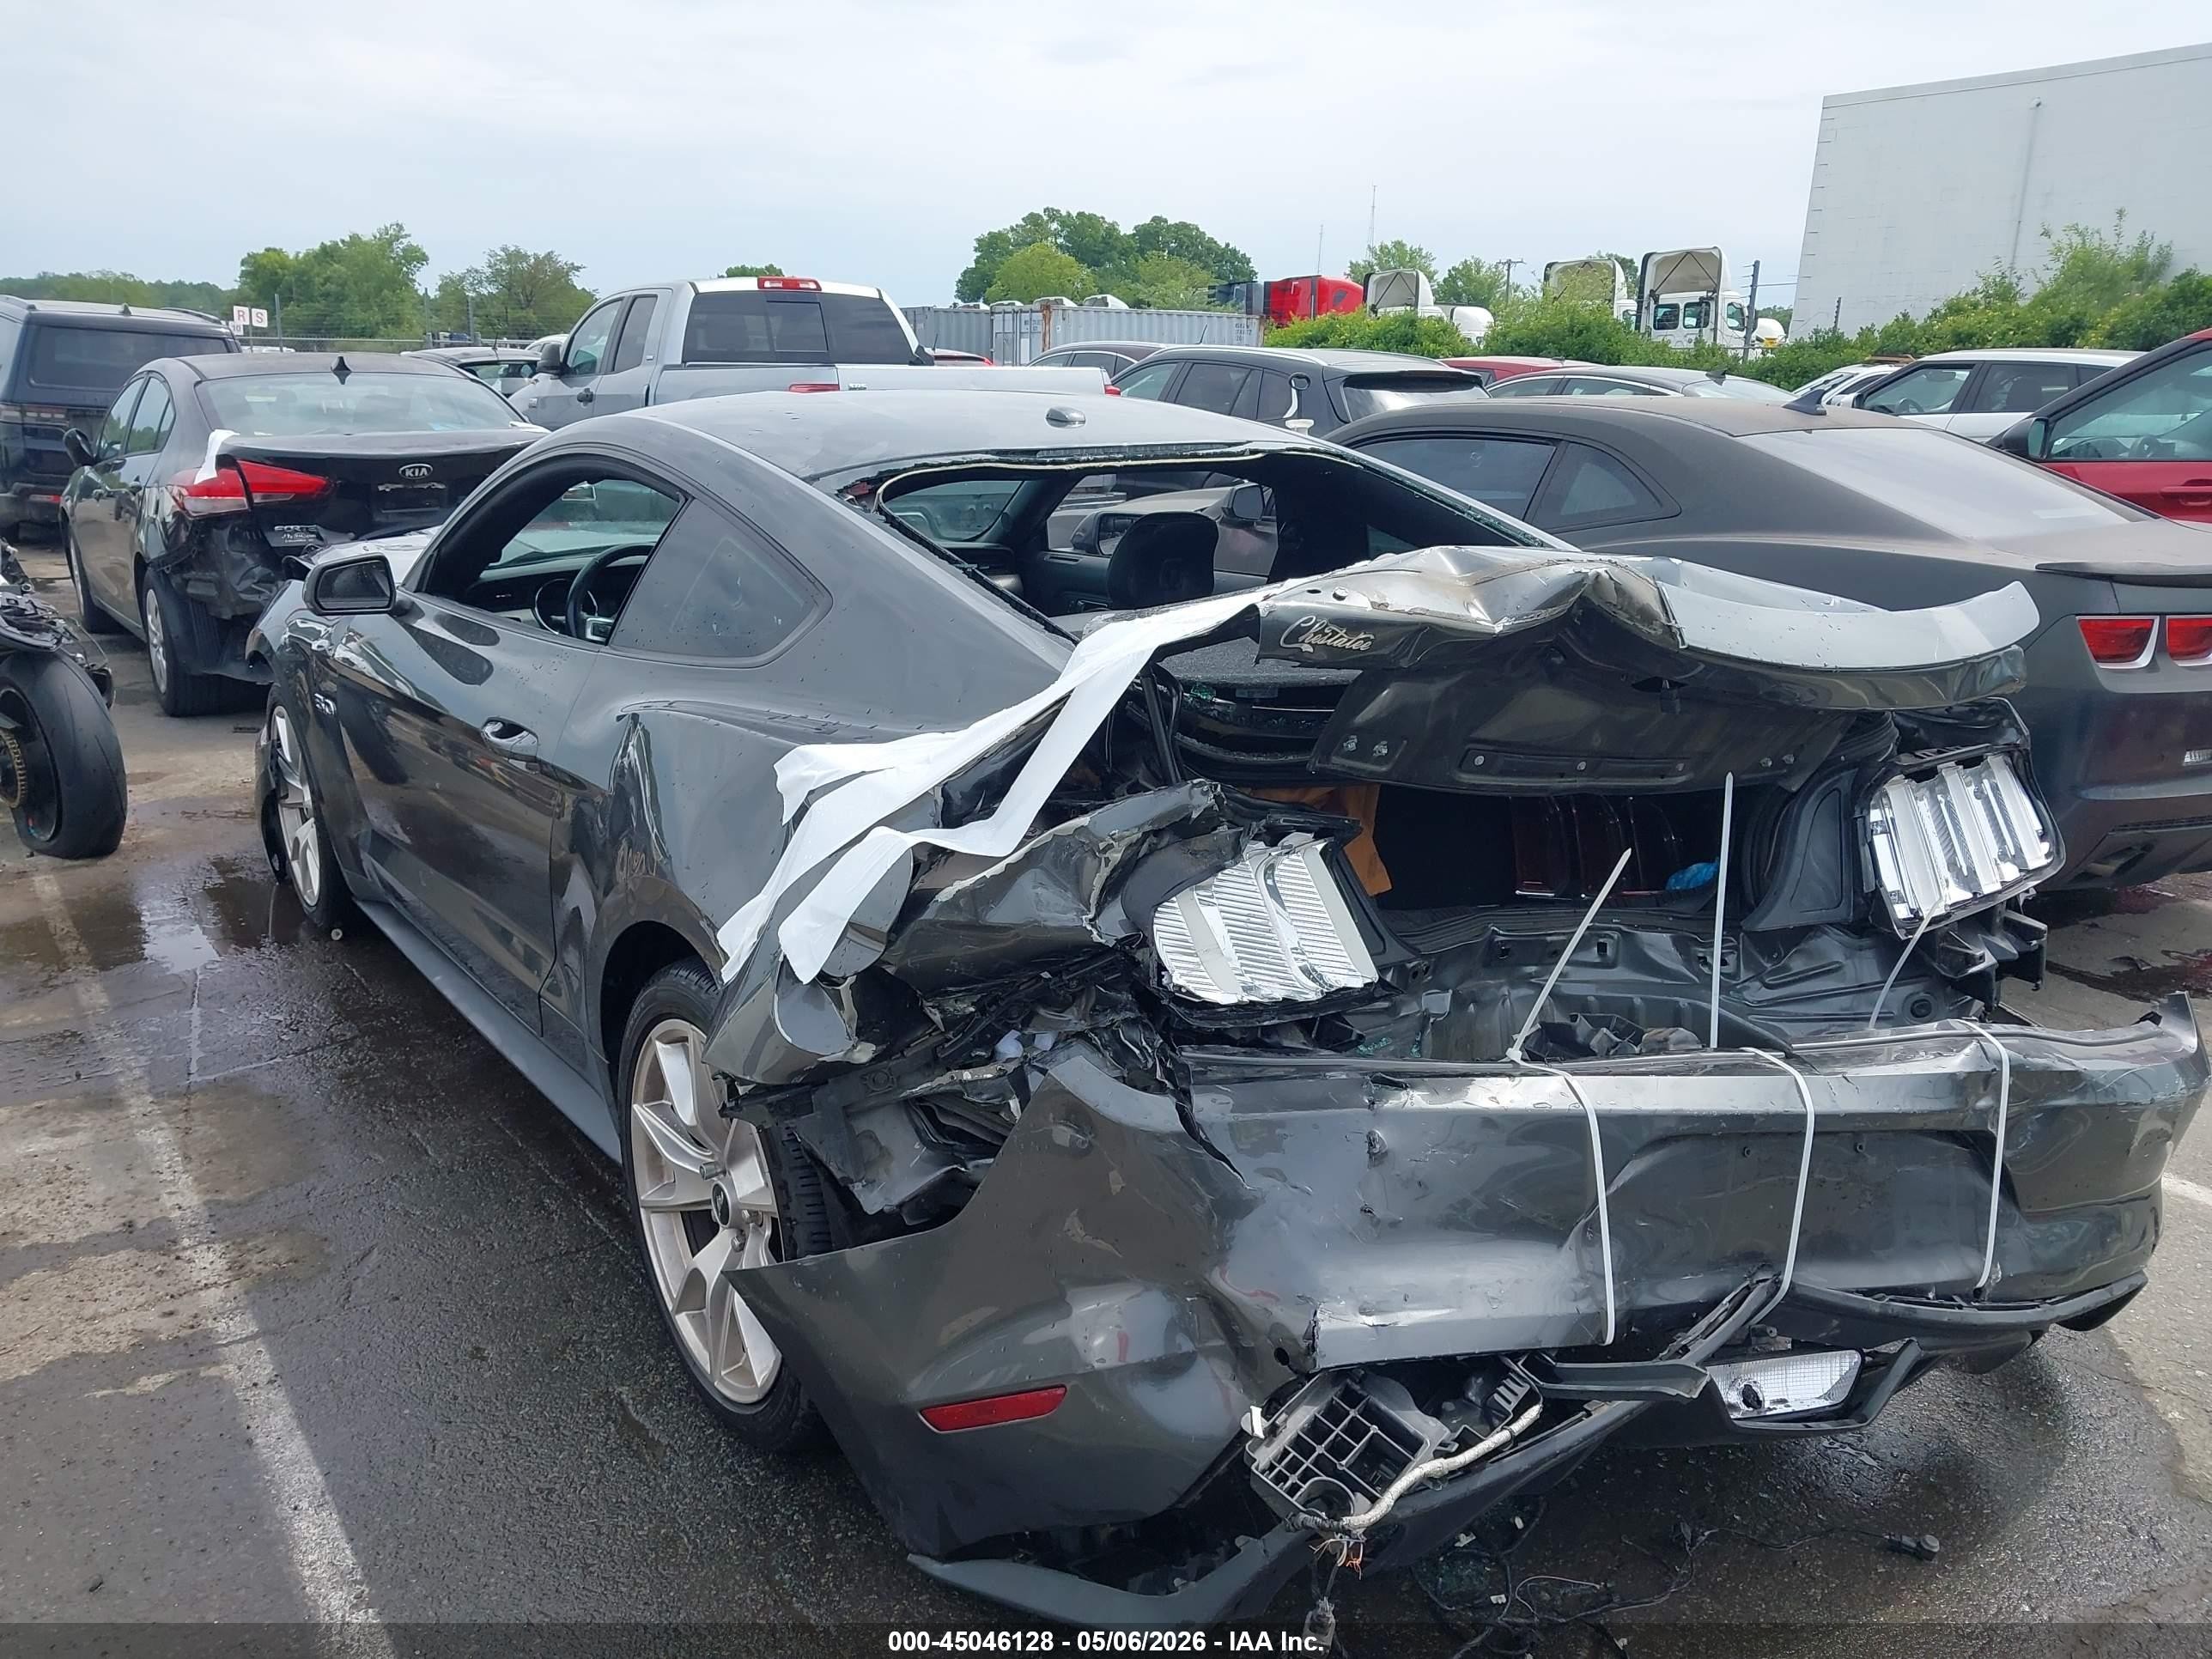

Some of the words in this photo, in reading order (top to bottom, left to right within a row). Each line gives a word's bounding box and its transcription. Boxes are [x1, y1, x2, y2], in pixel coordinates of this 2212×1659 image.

[237, 309, 246, 322] R
[255, 311, 264, 324] S
[404, 467, 428, 477] KIA
[1279, 615, 1375, 653] Chestatee
